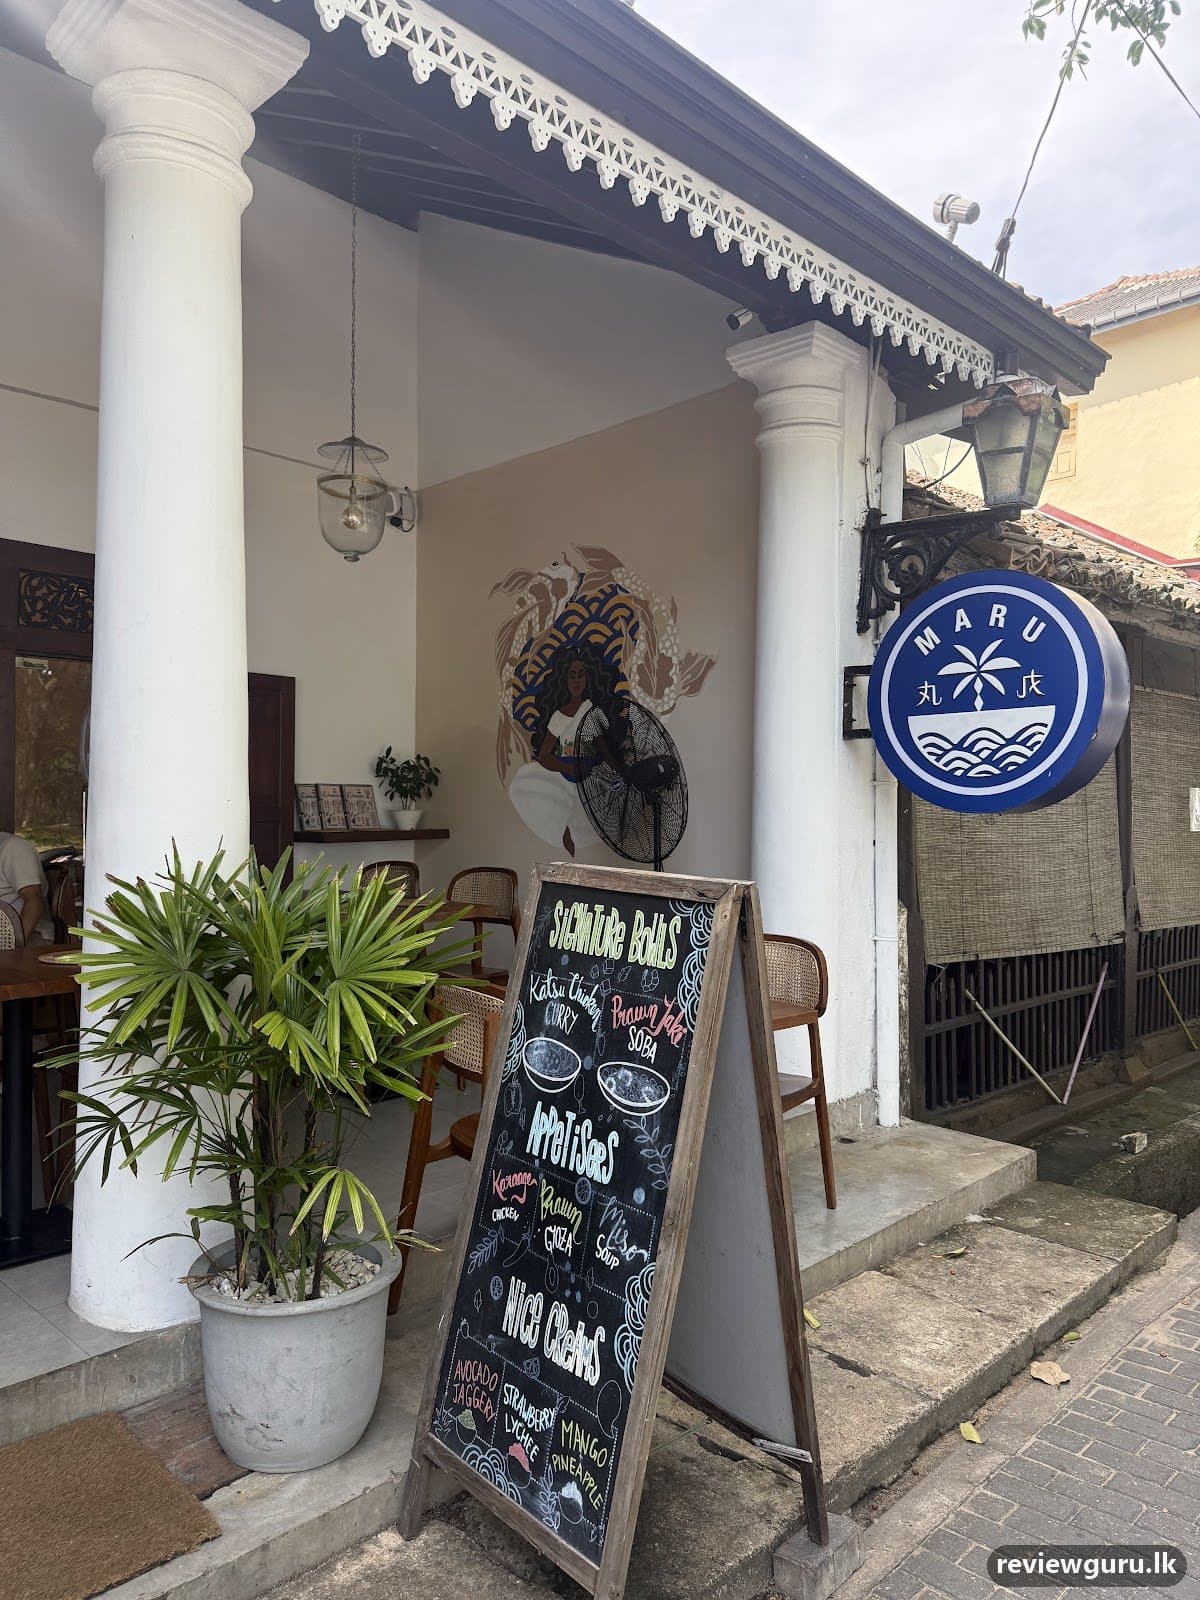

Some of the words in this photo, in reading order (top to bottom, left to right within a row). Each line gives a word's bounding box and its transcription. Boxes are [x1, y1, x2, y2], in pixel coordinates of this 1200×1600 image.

[913, 603, 1046, 656] MARU
[916, 680, 942, 707] 丸
[529, 968, 566, 1005] Katsu
[545, 1000, 579, 1036] CURRY
[611, 995, 658, 1029] Prawn
[628, 1026, 658, 1065] SOBA
[492, 1206, 520, 1222] CHICKEN
[540, 1179, 583, 1245] Prawn
[545, 1225, 573, 1258] GYOZA
[595, 1233, 620, 1270] SOUP
[454, 1359, 499, 1391] AVOCADO
[452, 1383, 497, 1422] JAGGERY
[503, 1383, 557, 1433] STRAWBERRY
[504, 1413, 540, 1462] LYCHEE
[561, 1419, 608, 1468] MANGO
[551, 1454, 605, 1511] PINEAPPLE
